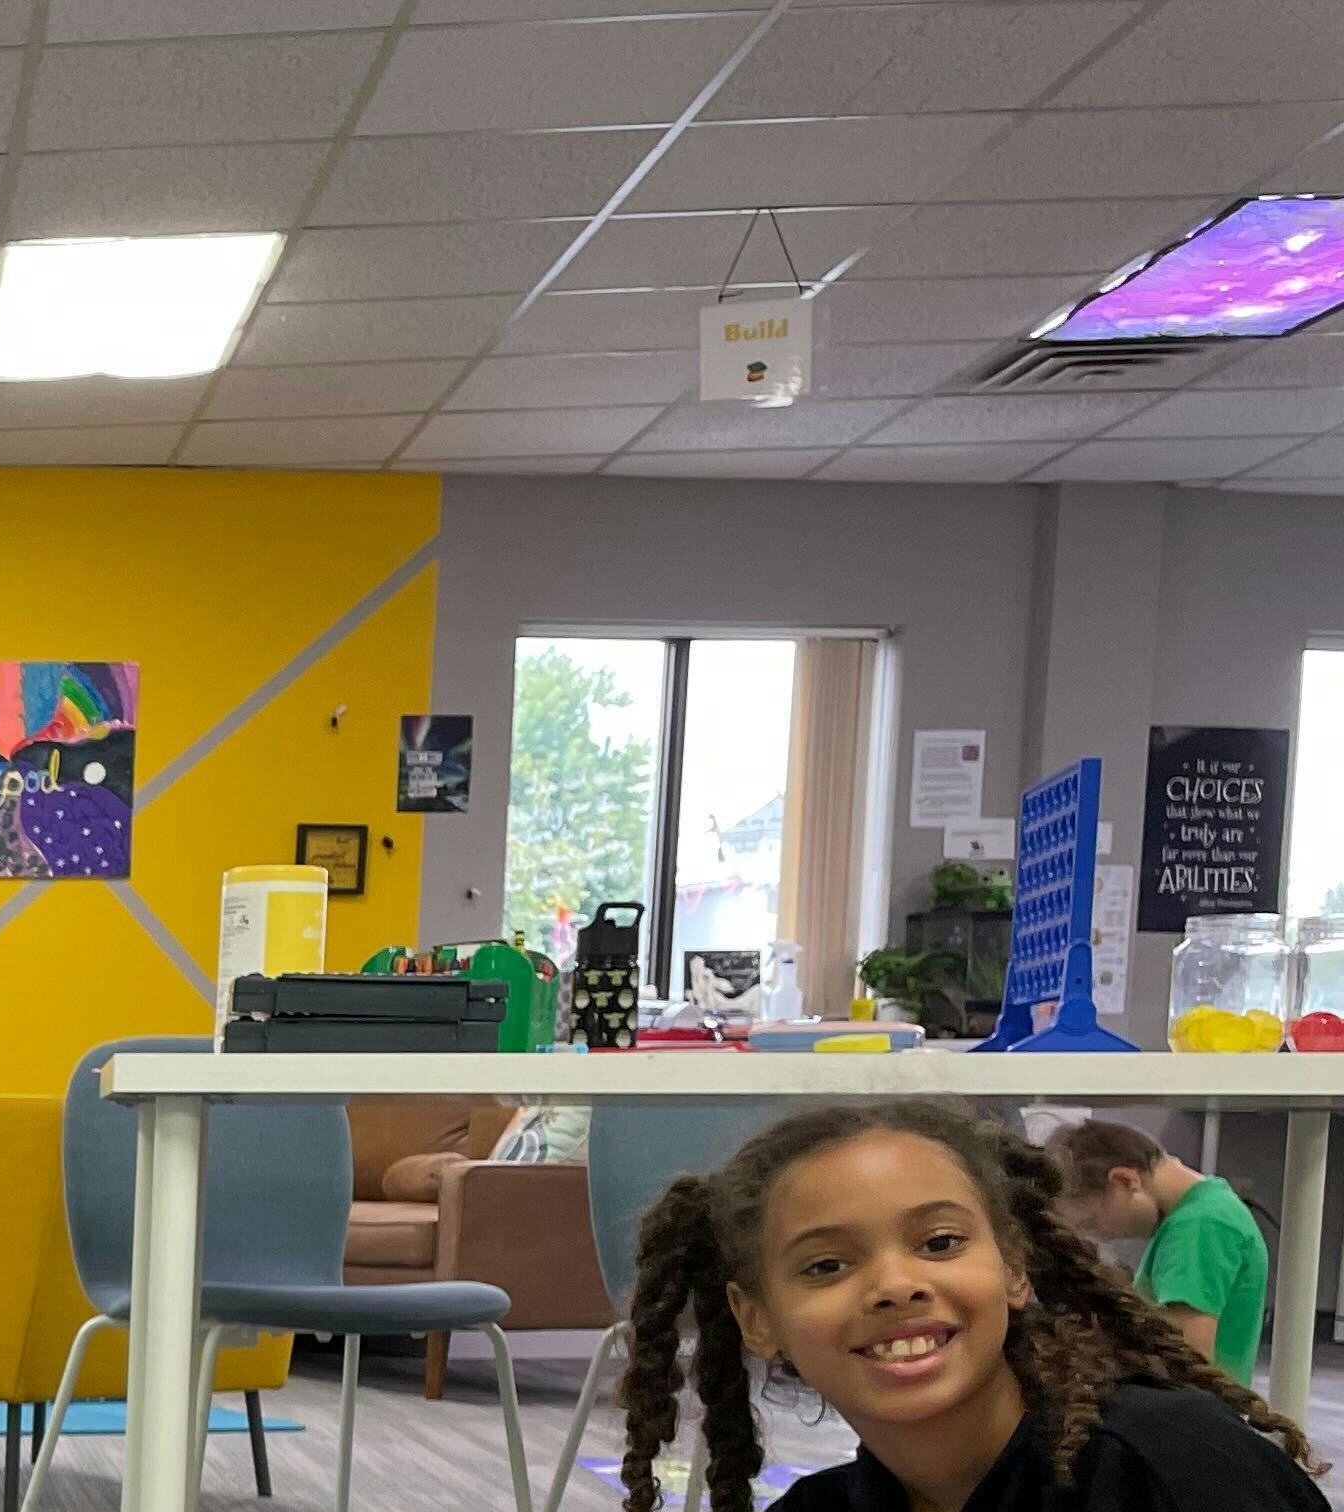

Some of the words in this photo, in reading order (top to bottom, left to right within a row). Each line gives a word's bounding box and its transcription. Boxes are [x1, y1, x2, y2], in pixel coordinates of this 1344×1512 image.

[723, 318, 789, 343] Build
[1166, 775, 1265, 804] CHOICES
[1180, 822, 1218, 849] truly
[1221, 827, 1245, 844] are
[1157, 863, 1259, 894] ABILITIES.
